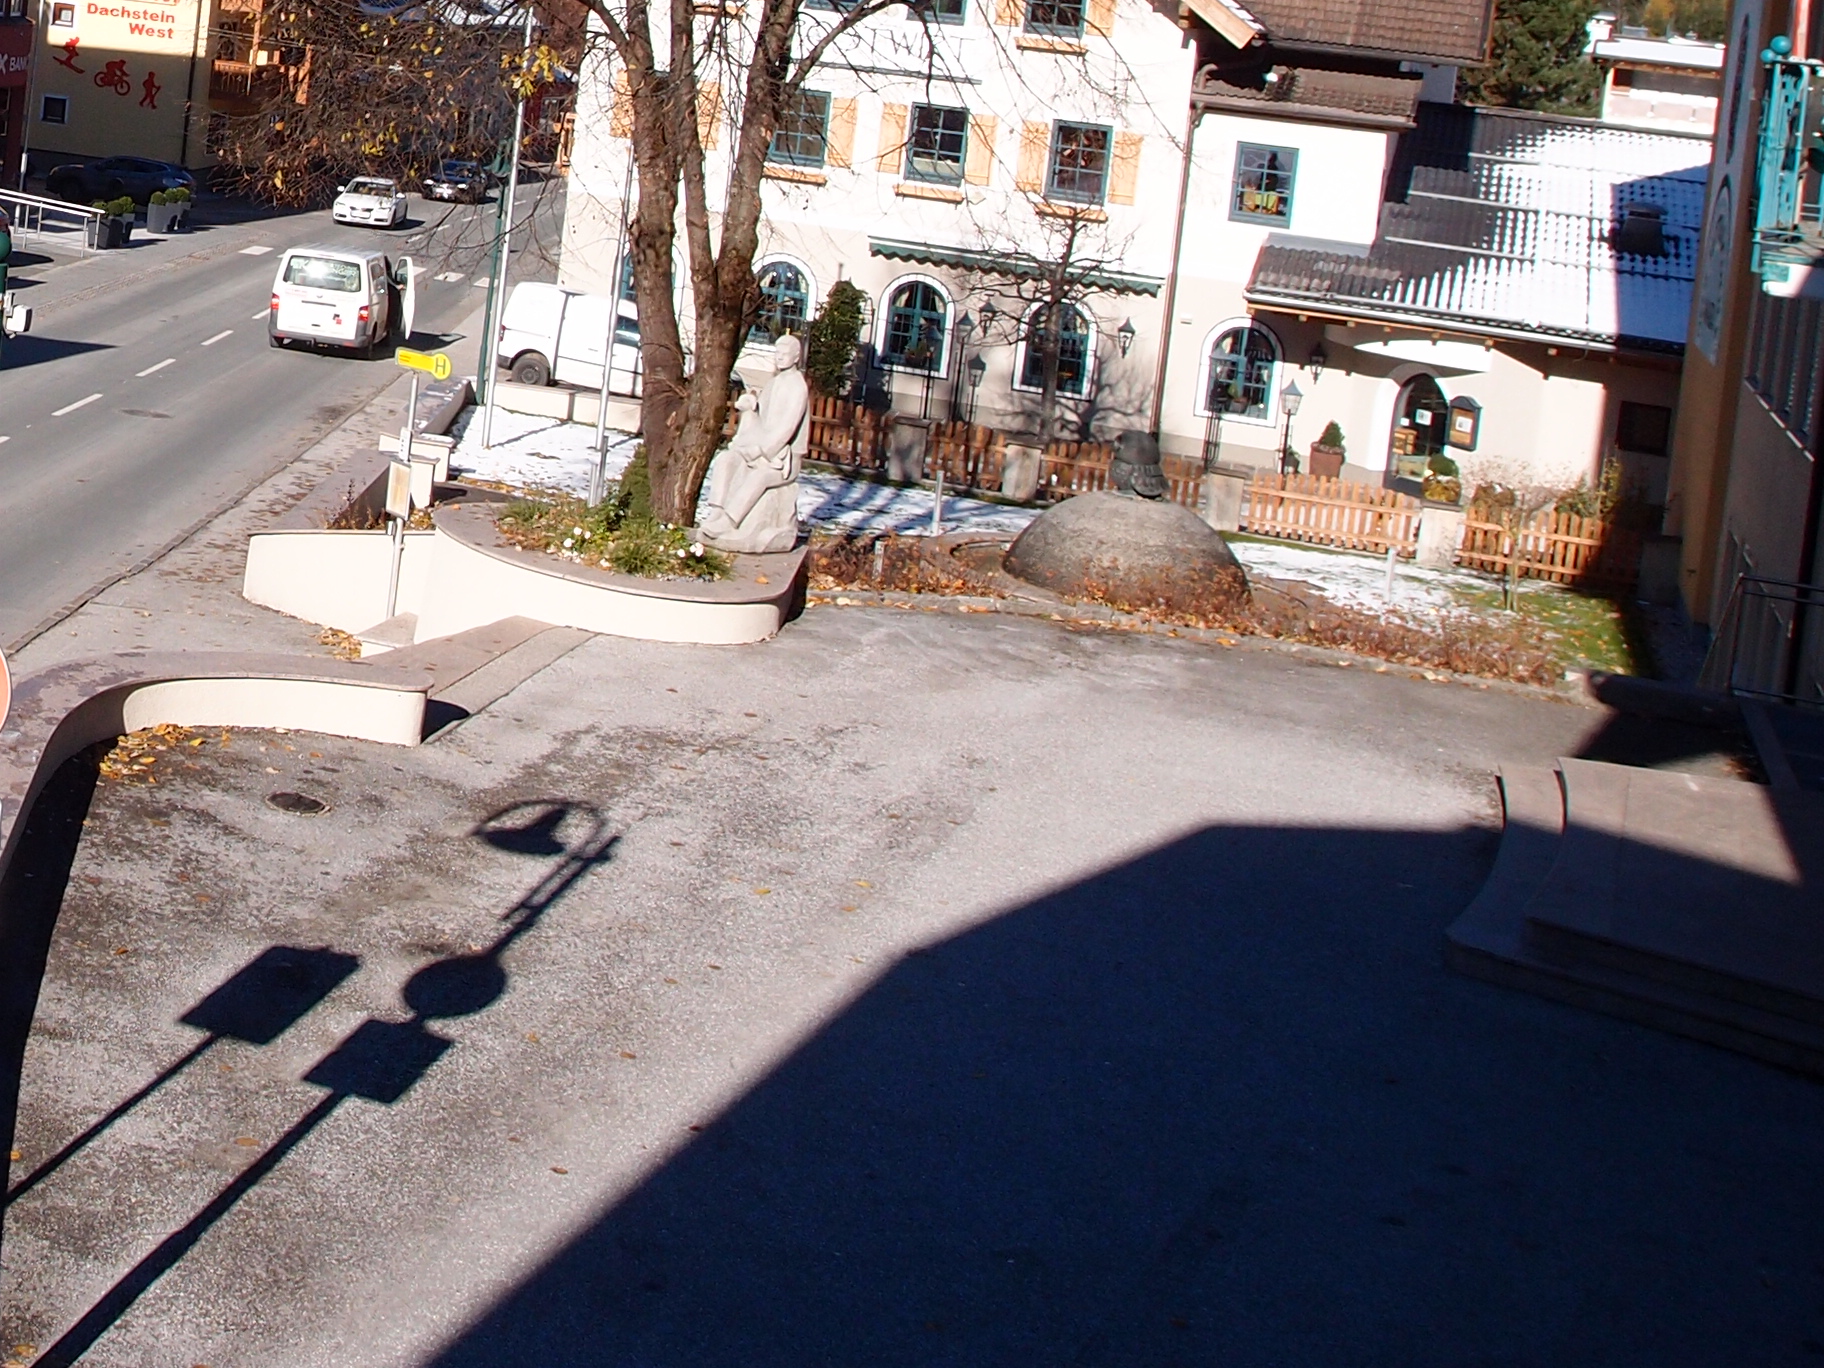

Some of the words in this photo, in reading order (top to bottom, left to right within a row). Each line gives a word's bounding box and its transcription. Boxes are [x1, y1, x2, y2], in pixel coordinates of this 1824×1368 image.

[87, 2, 175, 23] Dachstein
[128, 23, 174, 39] West
[435, 358, 447, 375] H
